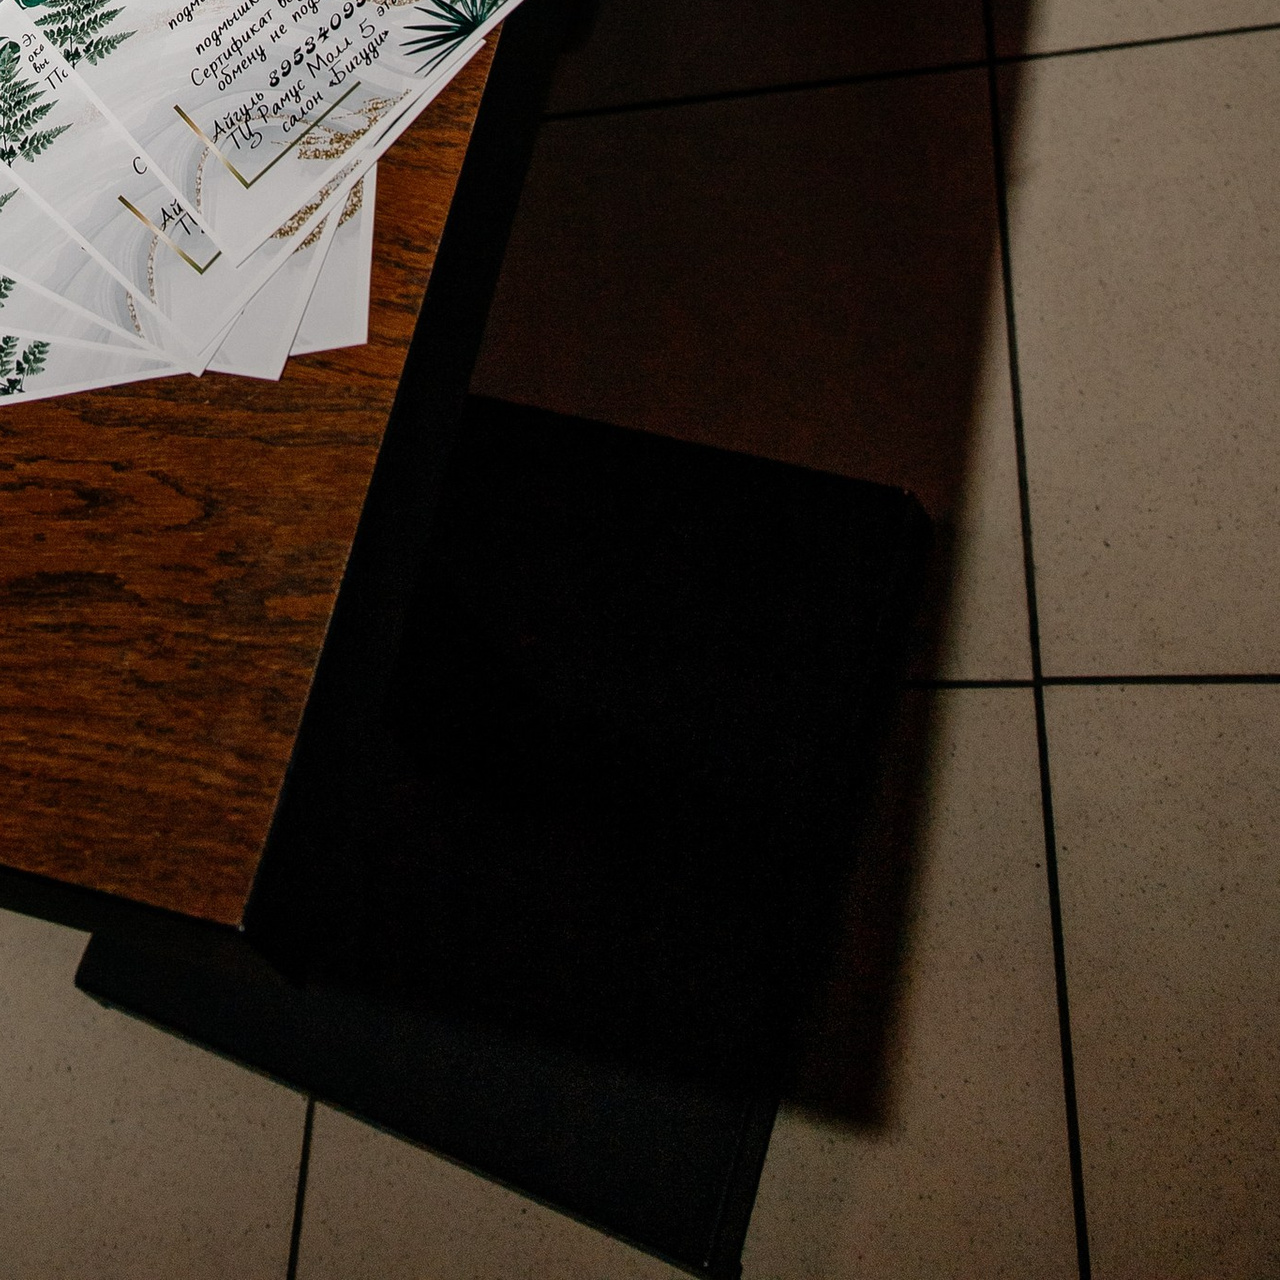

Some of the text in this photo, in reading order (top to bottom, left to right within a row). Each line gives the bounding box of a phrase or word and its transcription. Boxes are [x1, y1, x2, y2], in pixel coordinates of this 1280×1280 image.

[191, 9, 272, 86] Сертификат
[214, 45, 267, 91] обмену
[270, 24, 287, 43] не
[226, 116, 262, 149] ТЦ
[257, 80, 305, 123] Рамус
[306, 37, 353, 79] Молл
[359, 18, 375, 39] 5
[283, 91, 323, 133] салон
[213, 93, 265, 144] Айгуль
